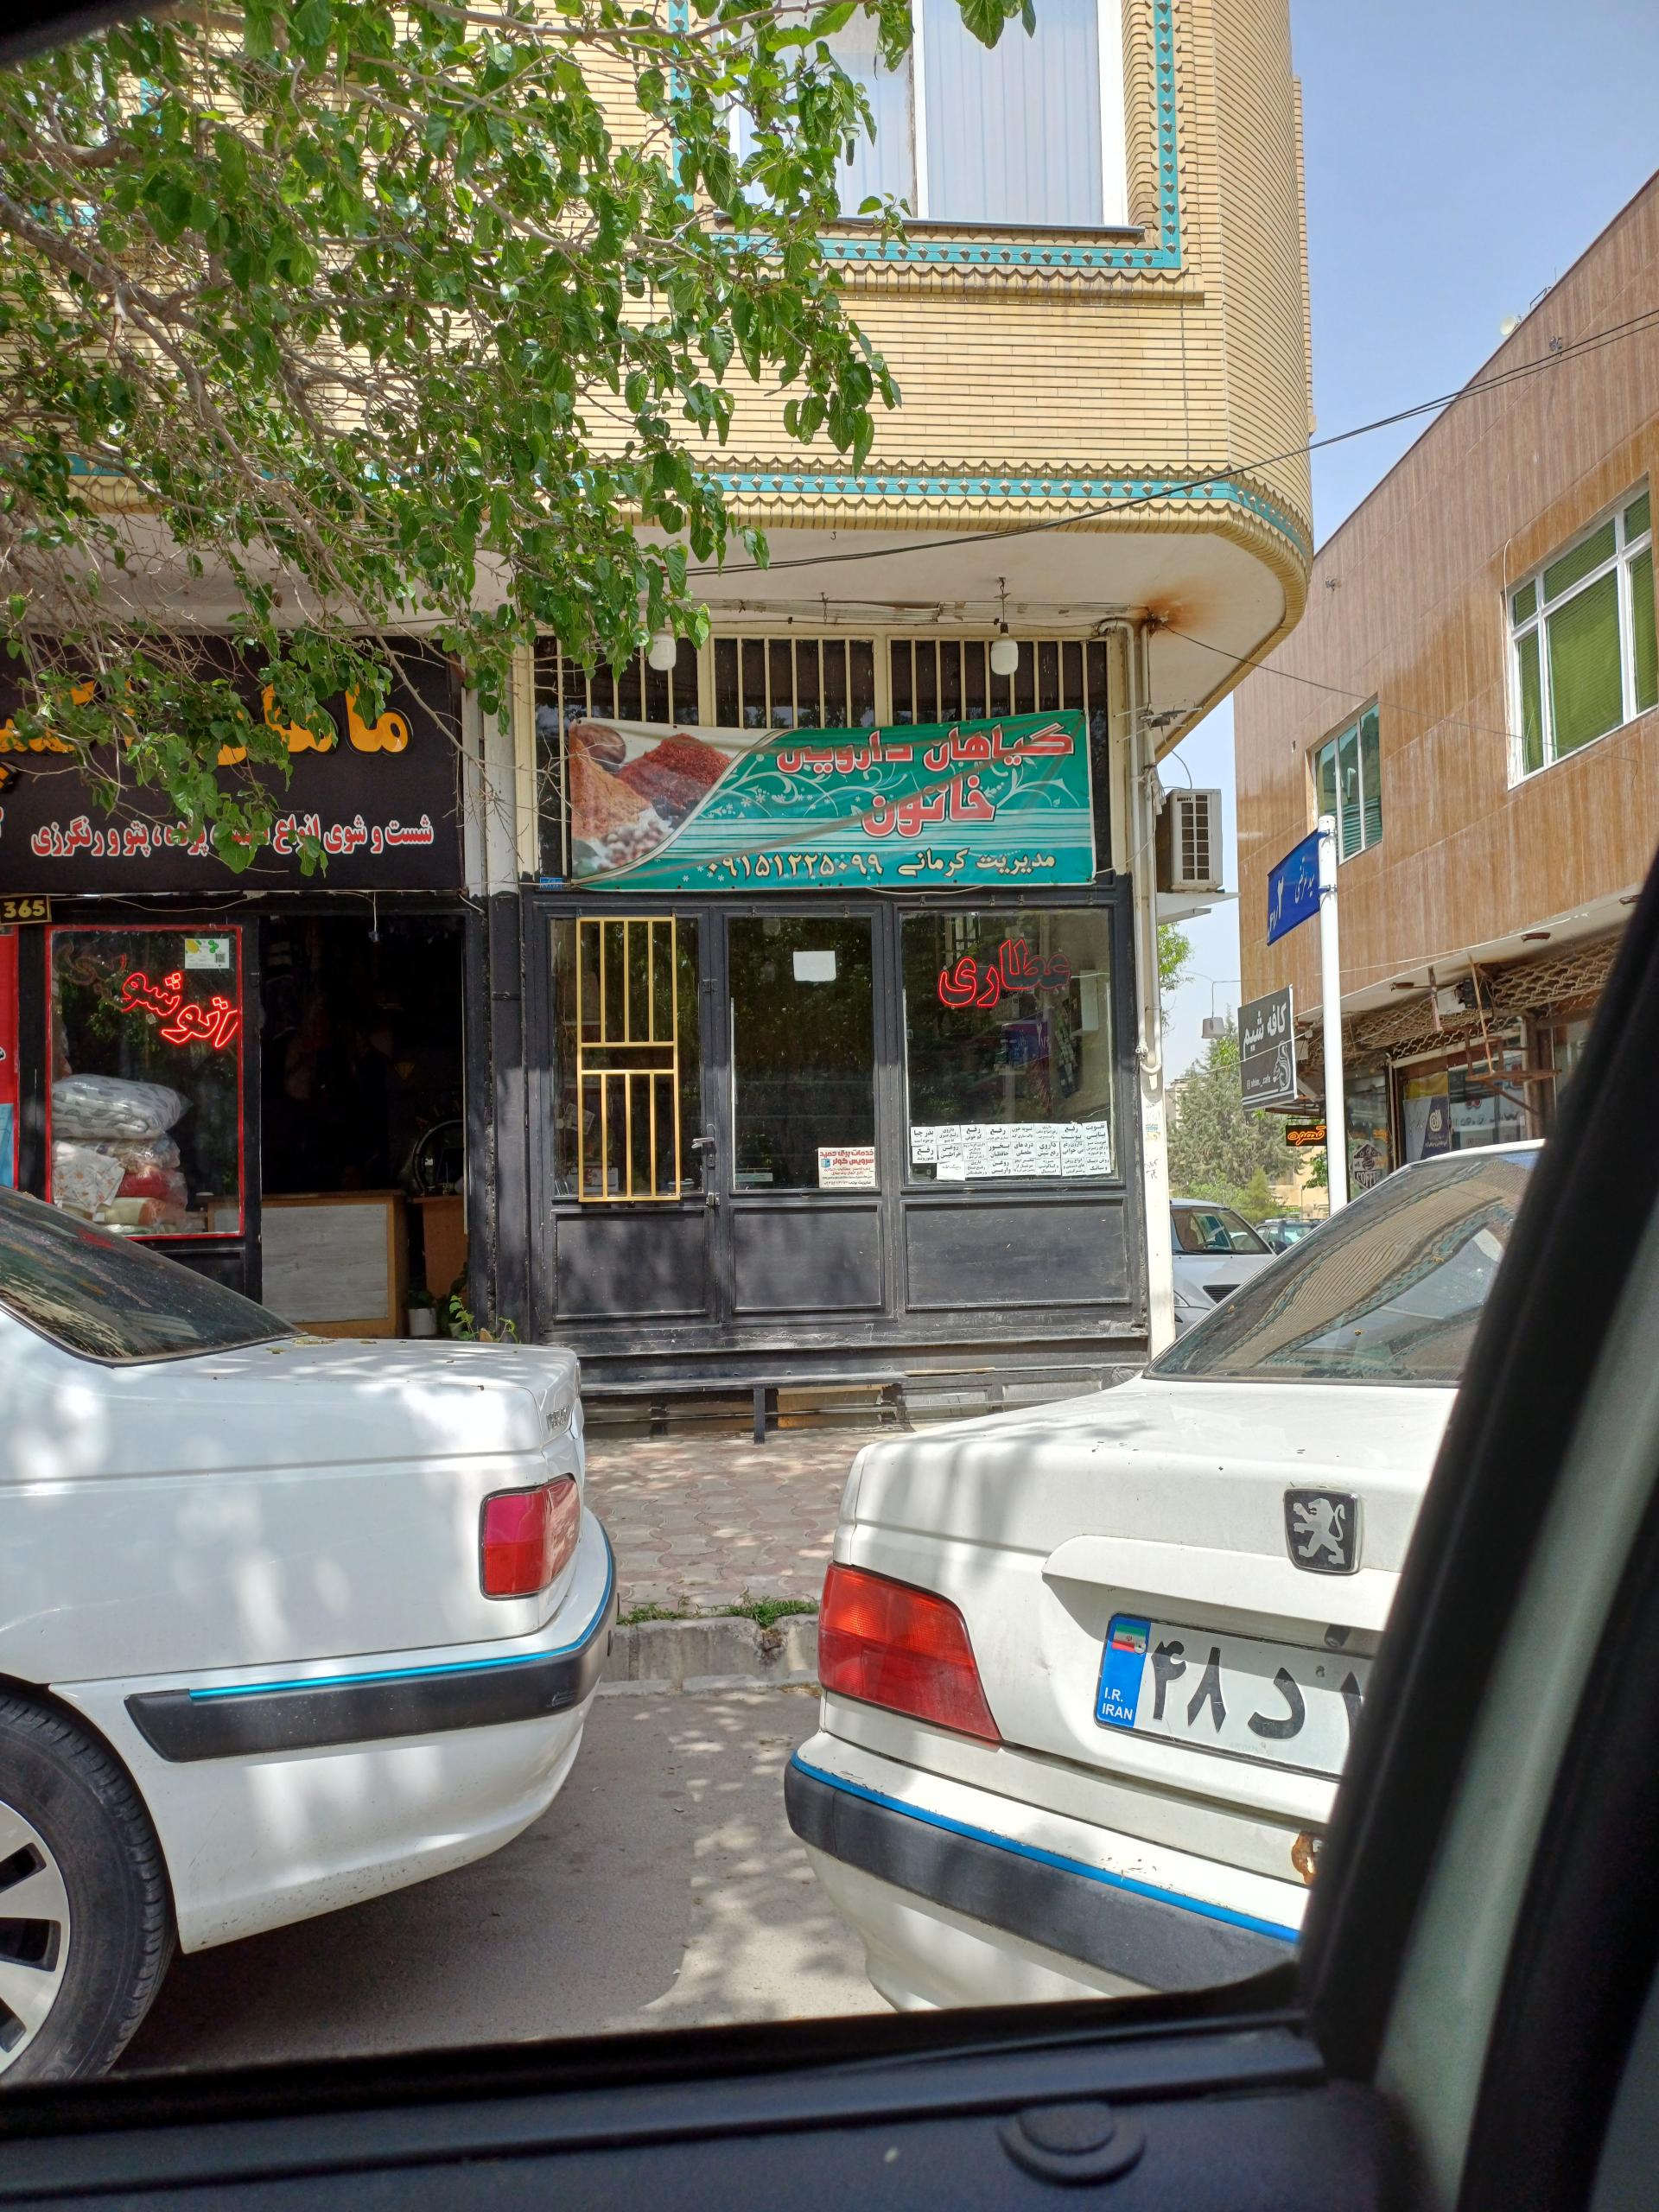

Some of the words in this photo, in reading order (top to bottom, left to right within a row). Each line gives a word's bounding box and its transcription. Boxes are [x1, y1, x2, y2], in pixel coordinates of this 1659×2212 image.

[776, 731, 914, 774] دارویی
[922, 722, 1075, 772] گیاهان
[861, 773, 997, 837] خاتون
[106, 828, 120, 856] و
[123, 820, 151, 857] پتو
[323, 814, 367, 854] شوی
[370, 826, 384, 855] و
[385, 814, 434, 845] شست
[708, 852, 884, 880] ۰۹۱۵۱۲۲۵۰۹۹
[976, 853, 1056, 874] مدیریت
[3, 899, 45, 918] 365
[938, 939, 1071, 1007] عطاری
[1267, 1001, 1287, 1036] کافه
[917, 1147, 934, 1155] رفع
[1104, 1687, 1123, 1702] I.R.
[1151, 1640, 1226, 1733] ۴۸
[1102, 1702, 1133, 1720] IRAN
